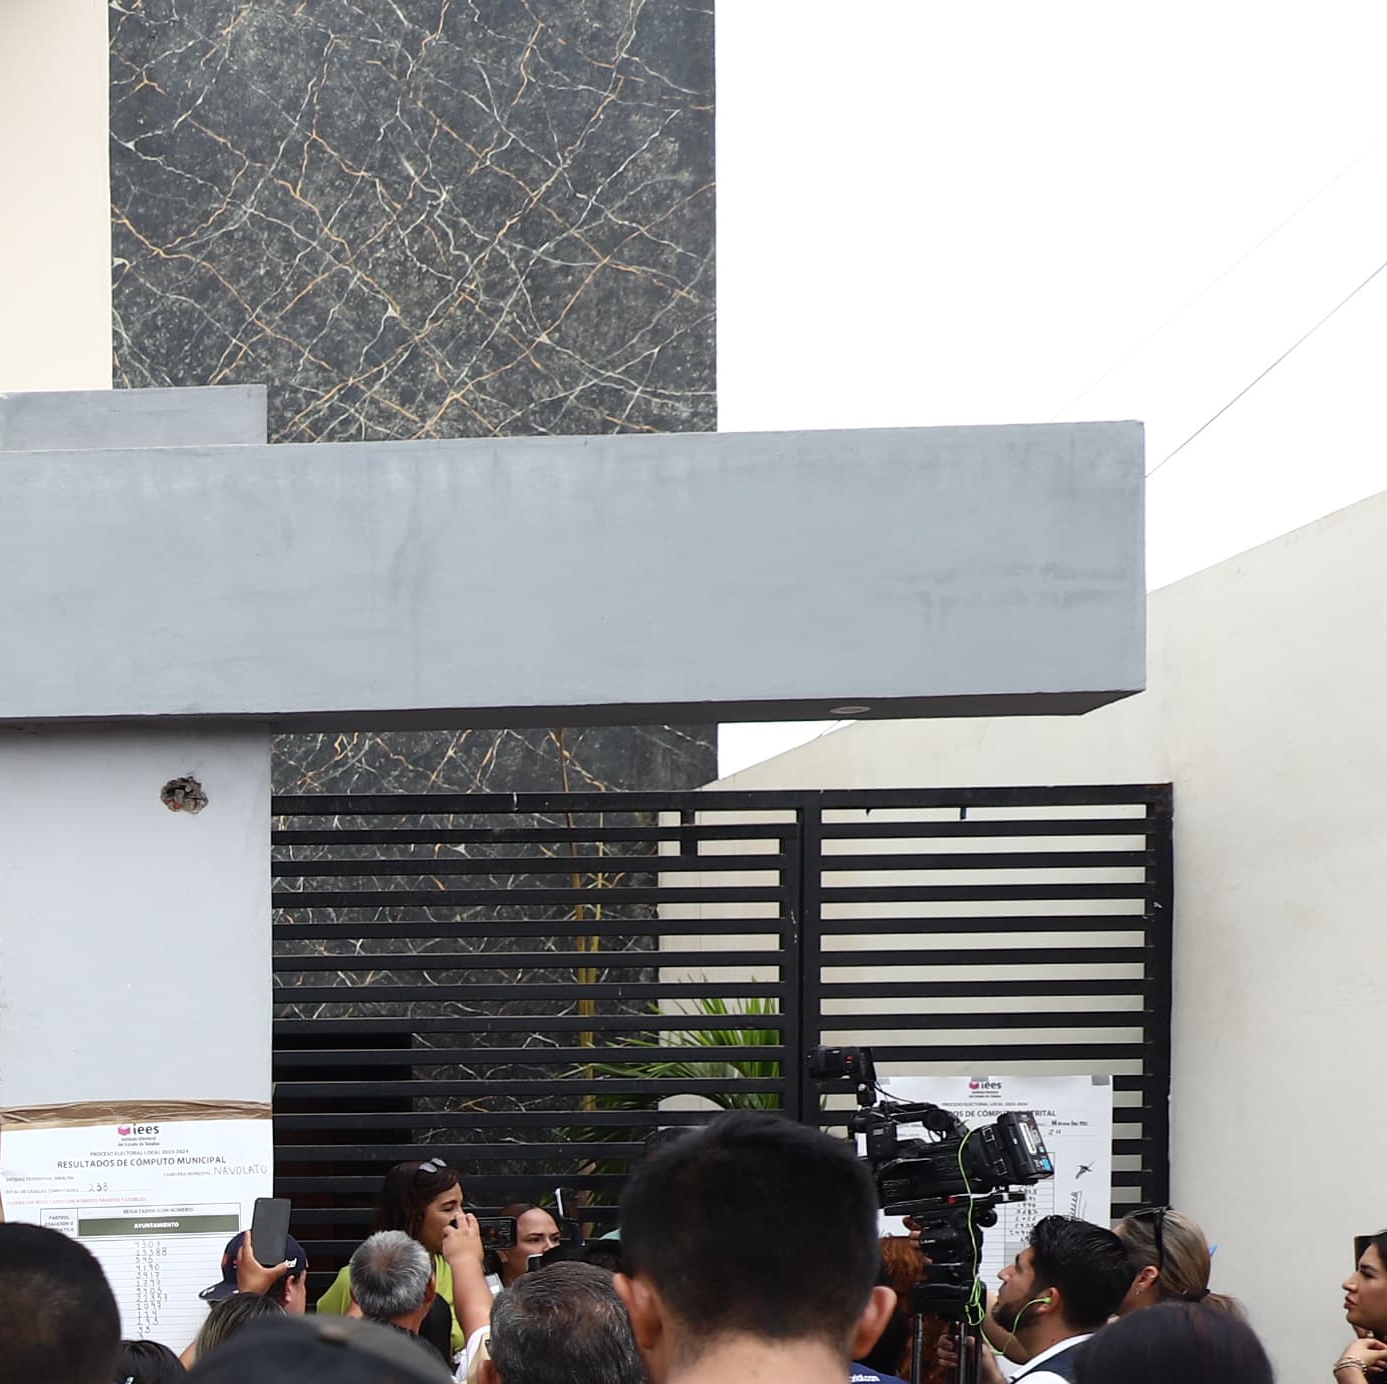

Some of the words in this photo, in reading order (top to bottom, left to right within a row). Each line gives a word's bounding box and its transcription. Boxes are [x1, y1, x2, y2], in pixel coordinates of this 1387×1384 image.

[133, 1124, 159, 1135] iees
[57, 1159, 115, 1168] RESULTADOS
[116, 1158, 128, 1167] DE
[130, 1156, 175, 1166] CÓMPUTO
[176, 1156, 226, 1165] MUNICIPAL
[213, 1164, 268, 1176] NAVOLATO
[134, 1221, 179, 1229] AYUNTAMIENTO
